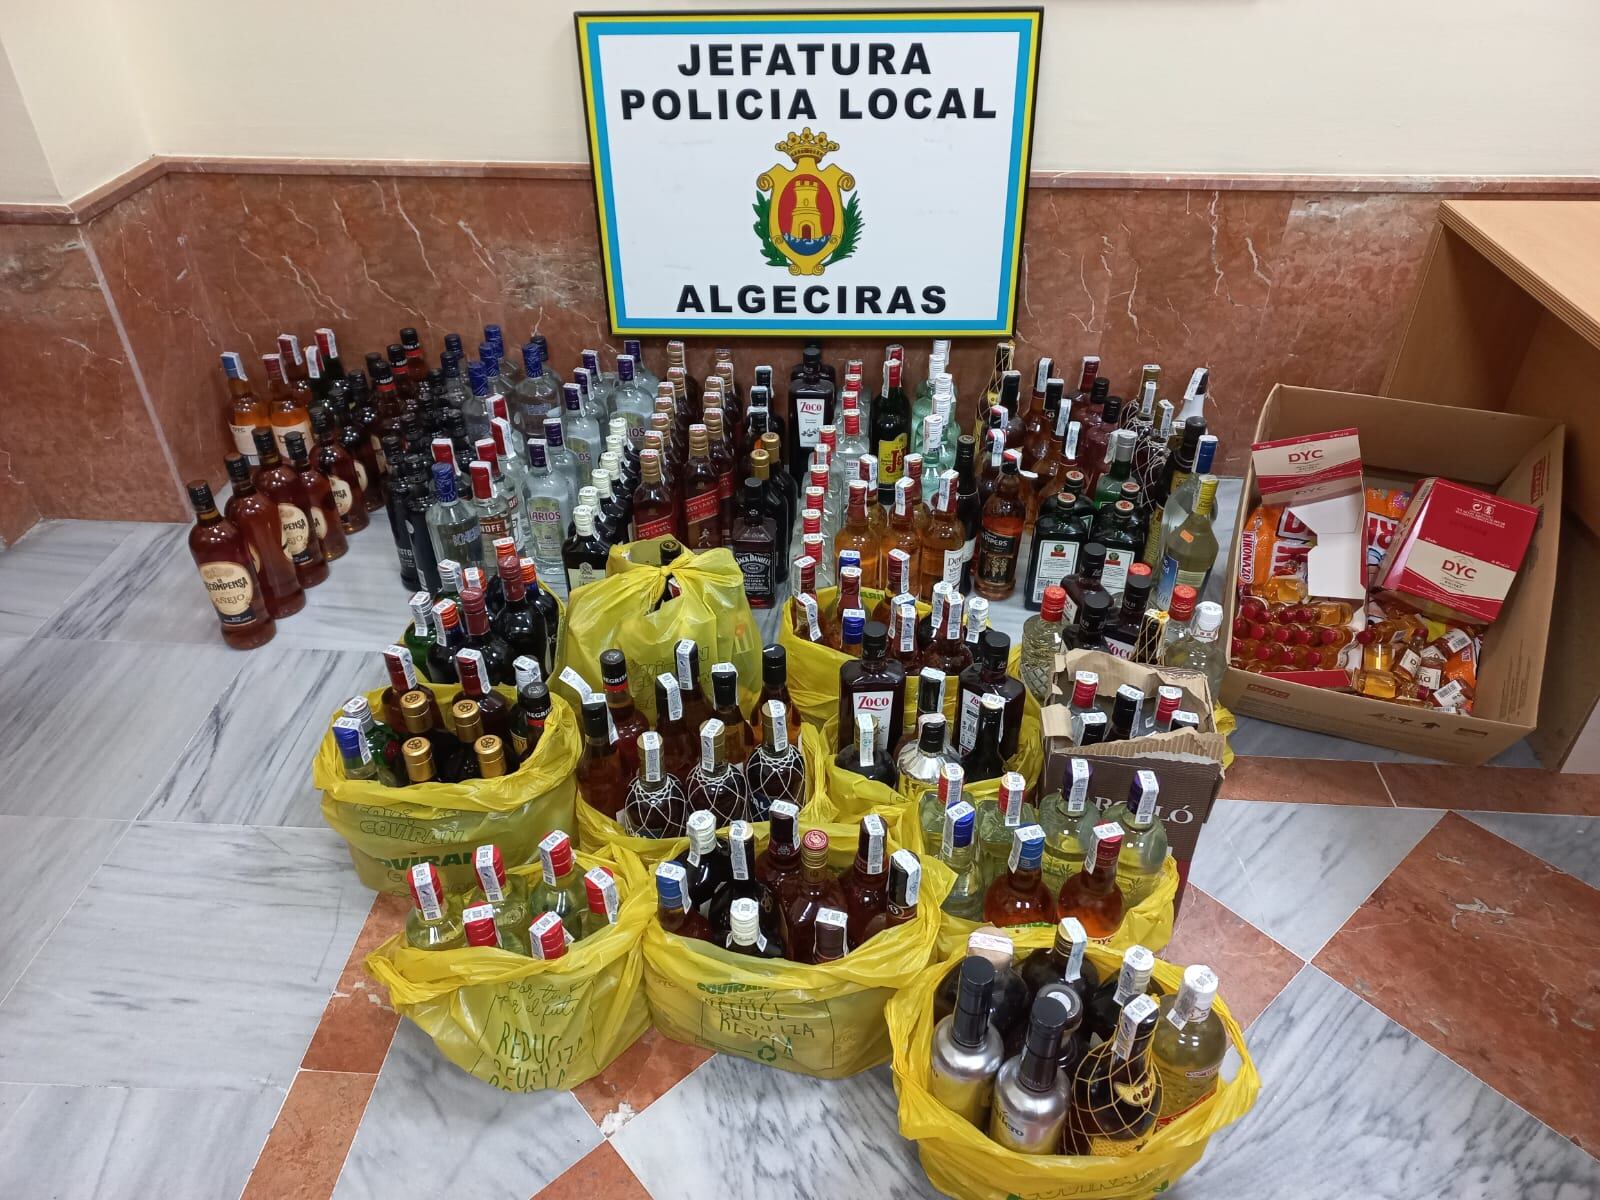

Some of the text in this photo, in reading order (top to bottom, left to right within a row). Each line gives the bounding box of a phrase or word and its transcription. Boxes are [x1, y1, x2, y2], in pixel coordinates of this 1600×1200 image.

[678, 43, 931, 76] JEFATURA
[621, 87, 997, 120] POLICIA LOCAL
[677, 285, 946, 314] ALGECIRAS
[1288, 449, 1324, 463] DYC
[480, 525, 502, 534] NOFF
[1239, 533, 1253, 580] KIKONAZO
[1441, 559, 1477, 579] DYC
[526, 706, 552, 718] NEGRI
[858, 695, 889, 710] ZOCO
[496, 1021, 561, 1064] REDUC
